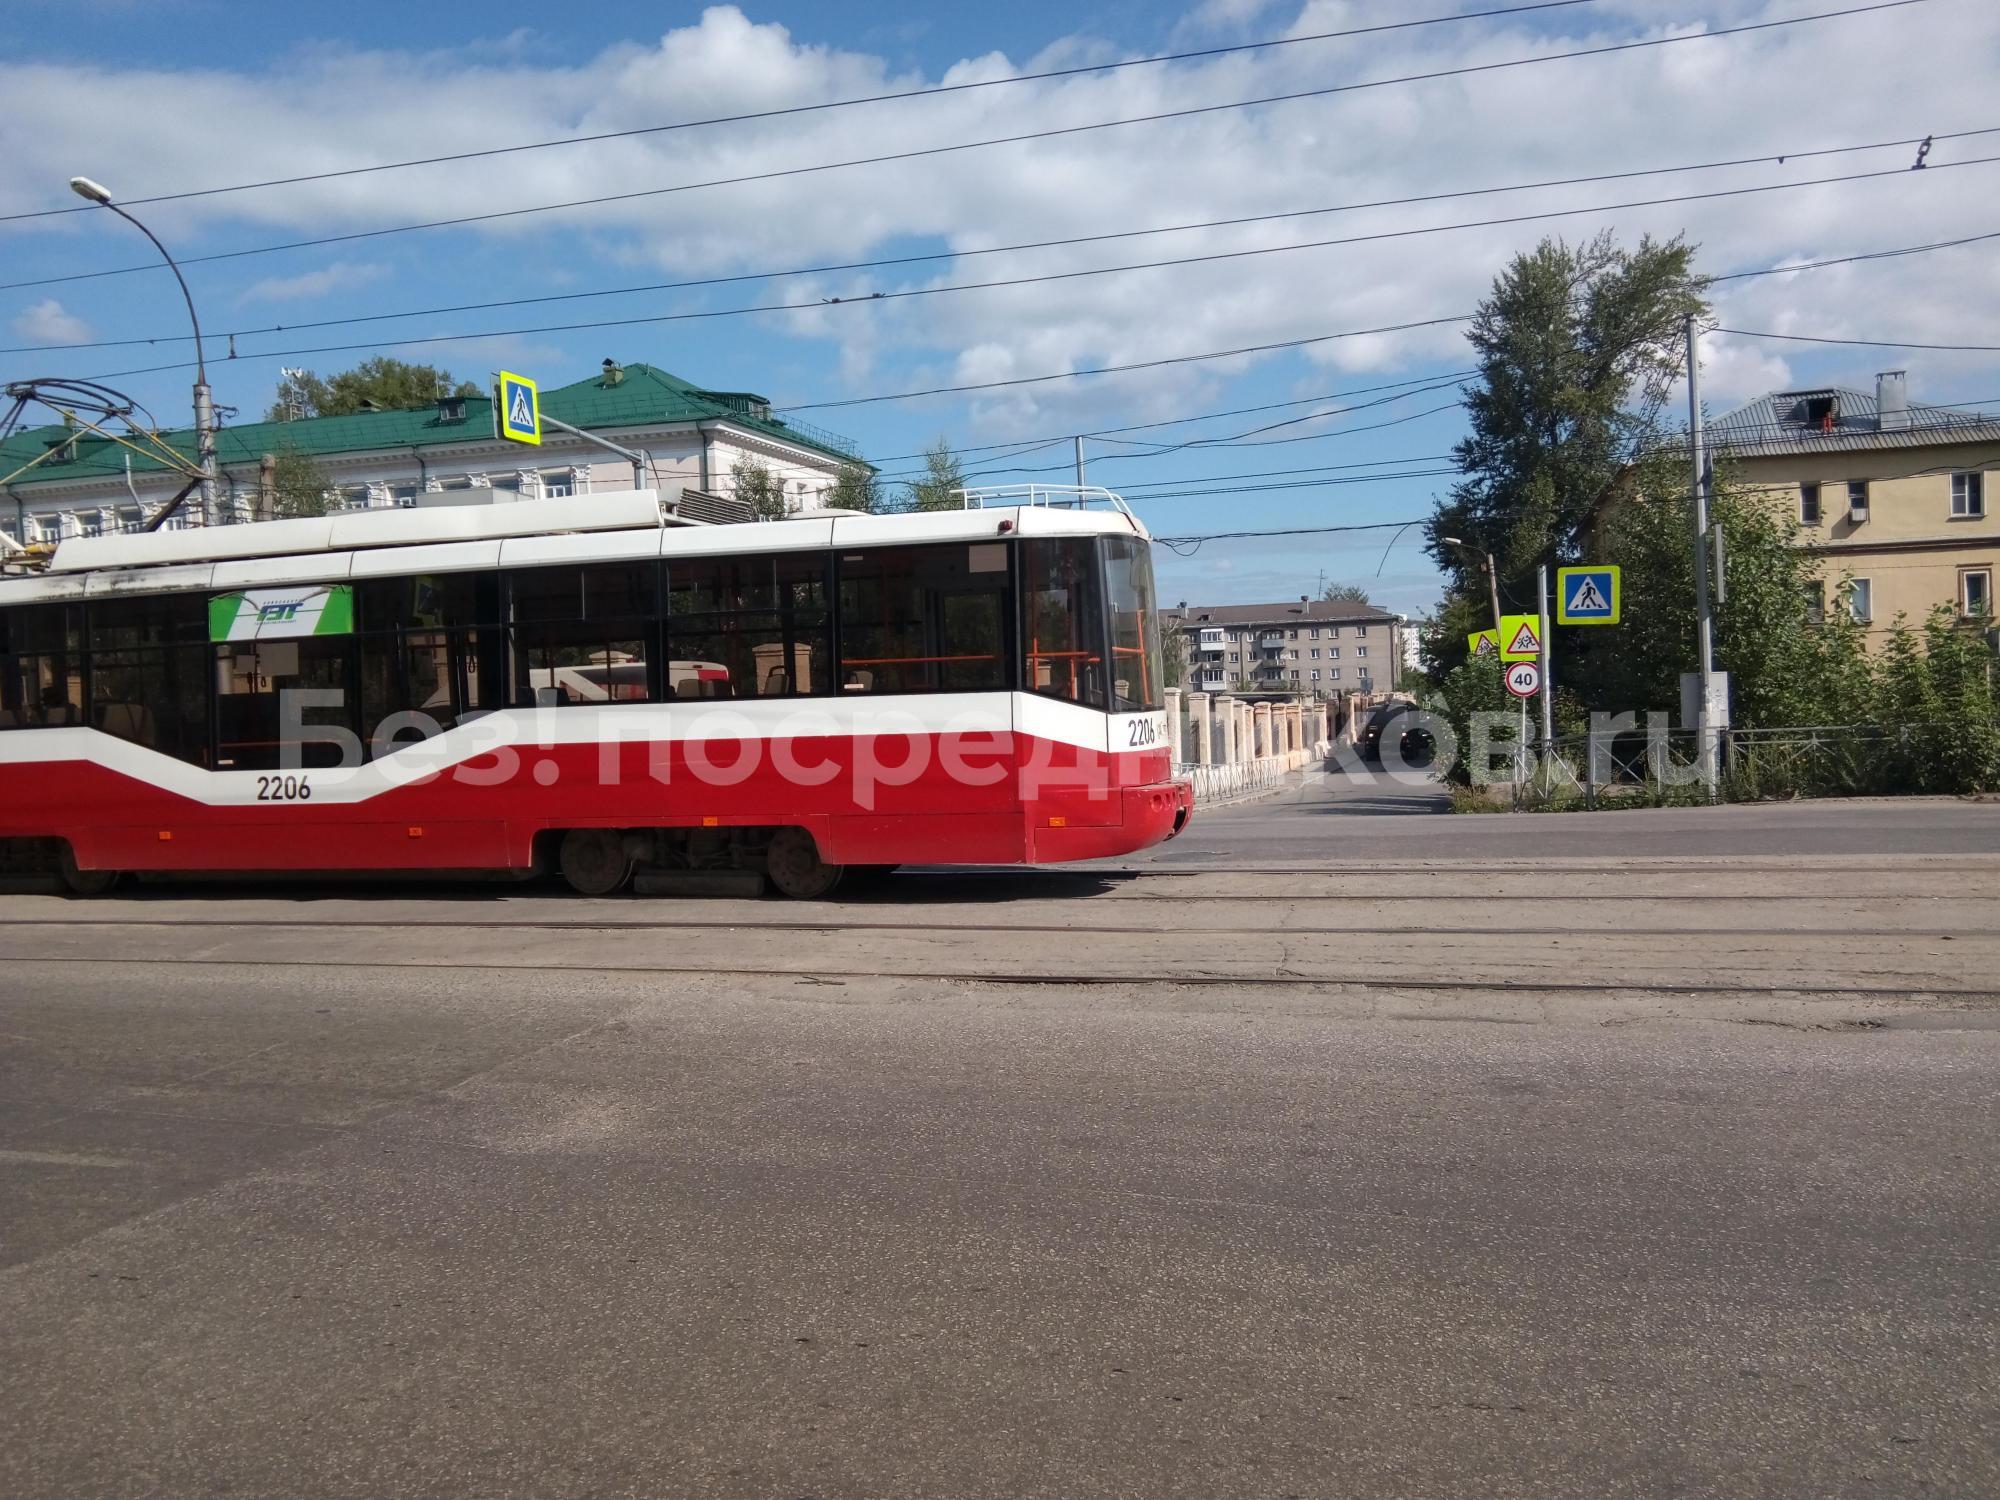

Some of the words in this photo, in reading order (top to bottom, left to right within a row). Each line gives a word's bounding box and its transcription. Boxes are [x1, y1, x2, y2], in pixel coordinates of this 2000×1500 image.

[1514, 673, 1532, 686] 40
[1128, 717, 1155, 747] 2206
[257, 775, 311, 801] 2206
